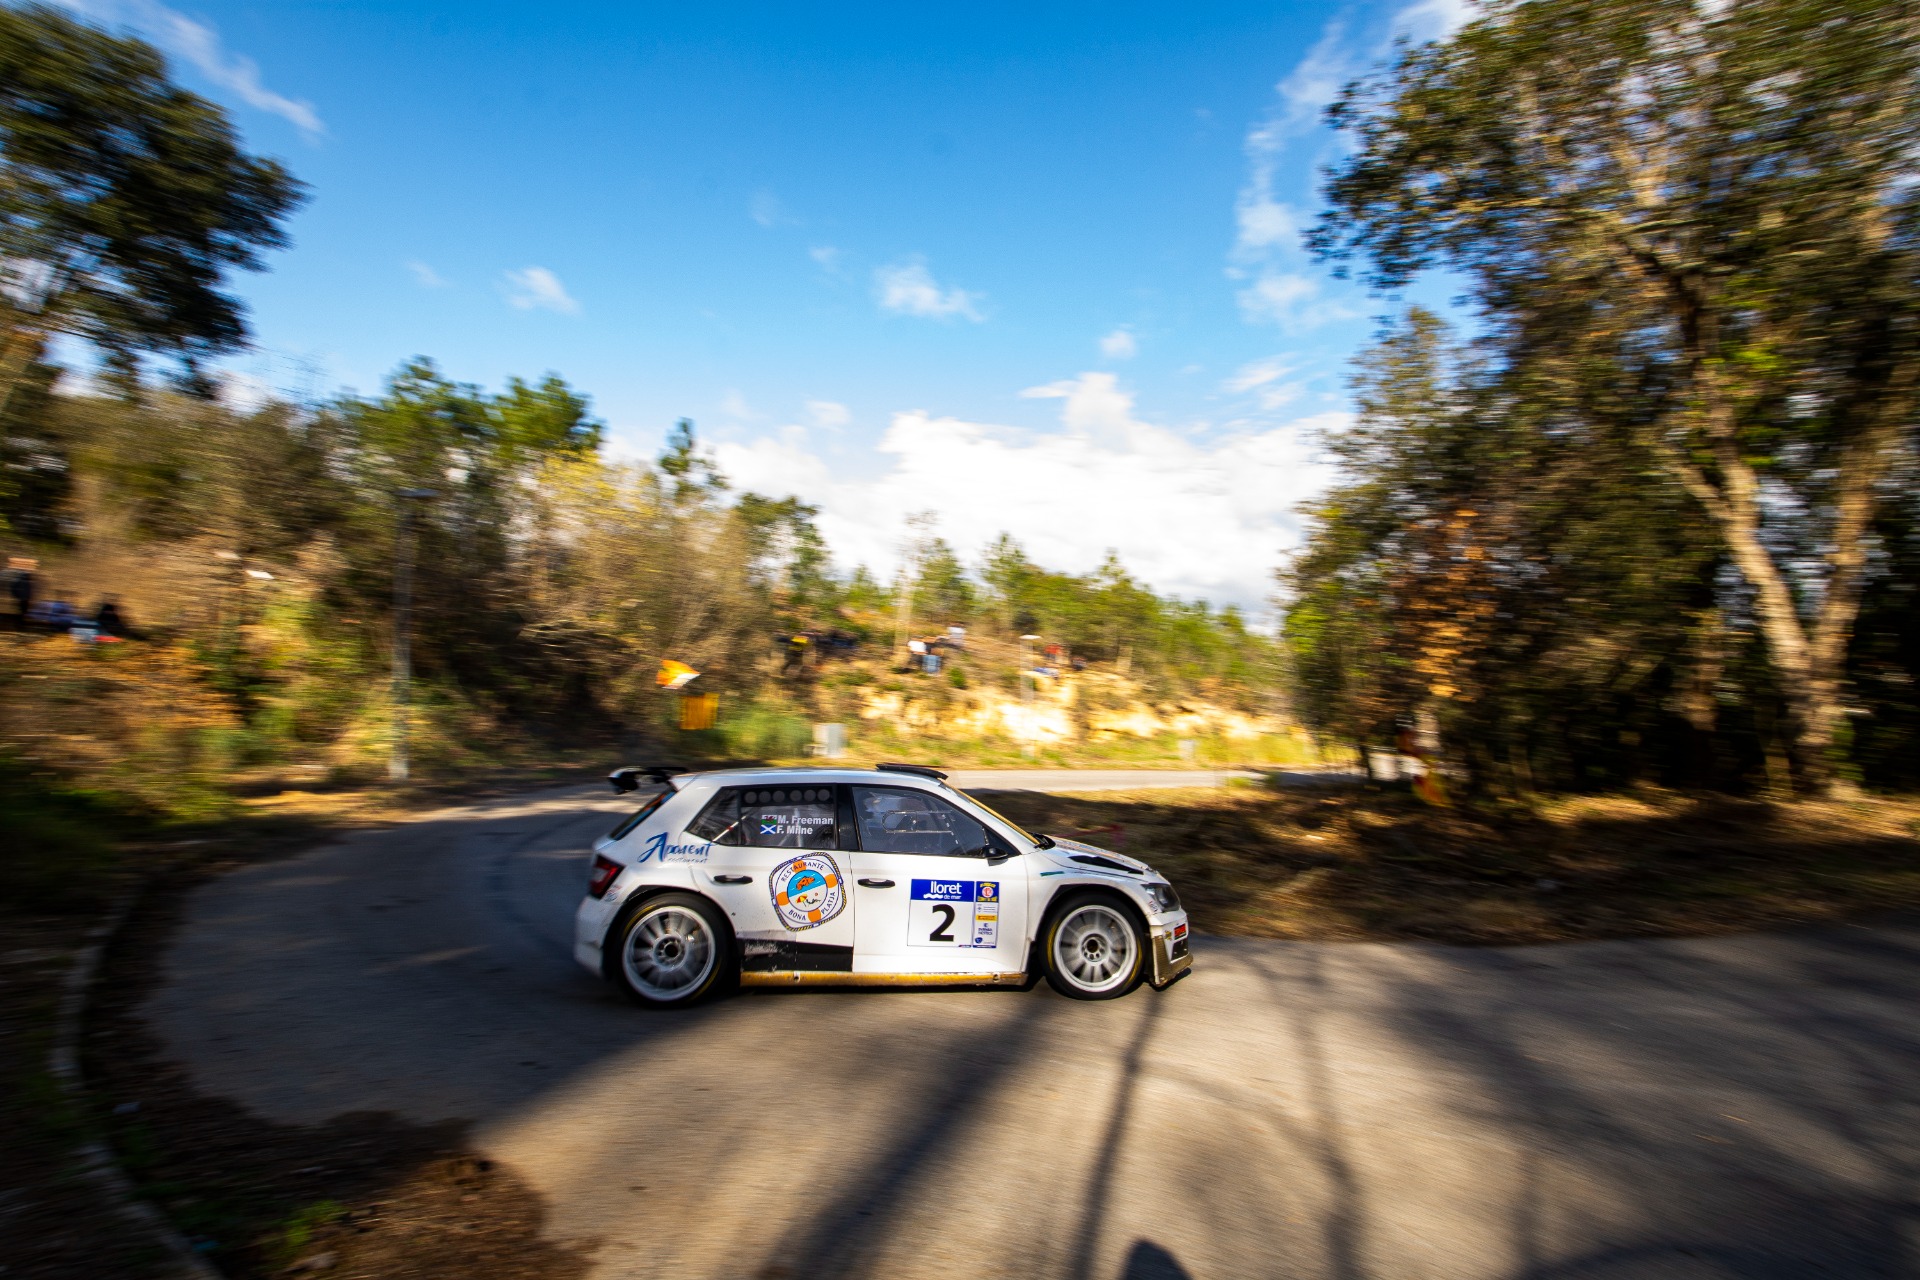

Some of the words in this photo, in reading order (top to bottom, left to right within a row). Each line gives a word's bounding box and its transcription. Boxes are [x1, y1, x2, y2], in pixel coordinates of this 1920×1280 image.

[777, 815, 789, 824] M.
[792, 815, 834, 825] Freeman
[776, 825, 785, 834] F.
[787, 825, 814, 835] Milne
[781, 861, 825, 882] RESTAURANTE
[931, 881, 962, 894] lloret
[820, 891, 836, 914] PLATJA
[788, 909, 806, 921] BONA
[929, 904, 955, 941] 2
